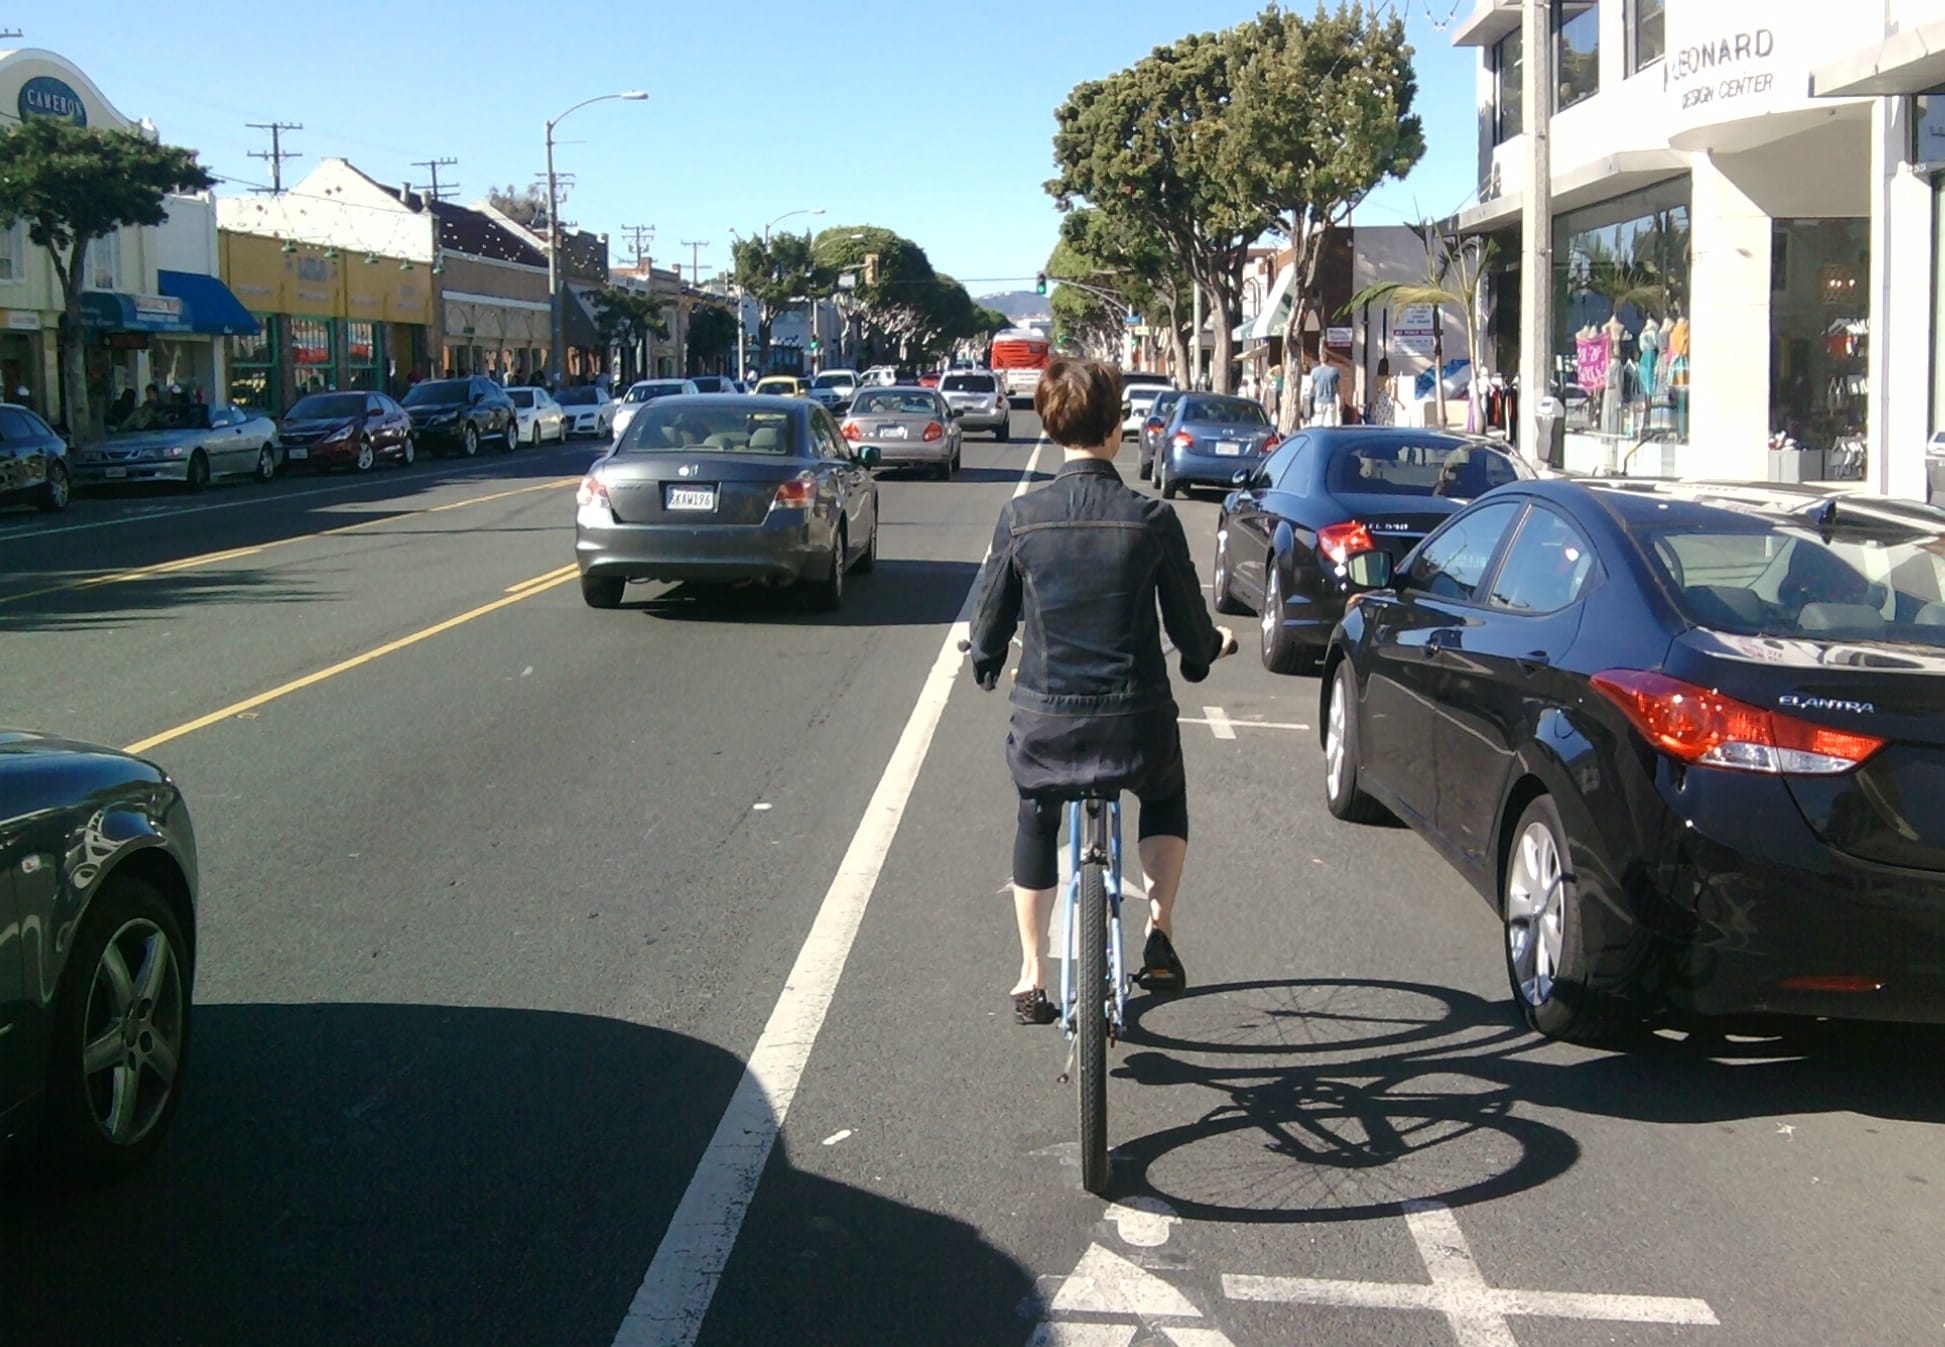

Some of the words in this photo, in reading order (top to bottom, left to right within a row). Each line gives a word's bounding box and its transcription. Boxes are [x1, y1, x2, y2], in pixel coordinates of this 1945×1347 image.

[1673, 29, 1773, 80] LEONARD
[26, 89, 82, 115] CAMERON
[1682, 86, 1714, 110] DESIGN
[1719, 73, 1773, 99] CENTER
[1779, 695, 1875, 713] ELANTRA
